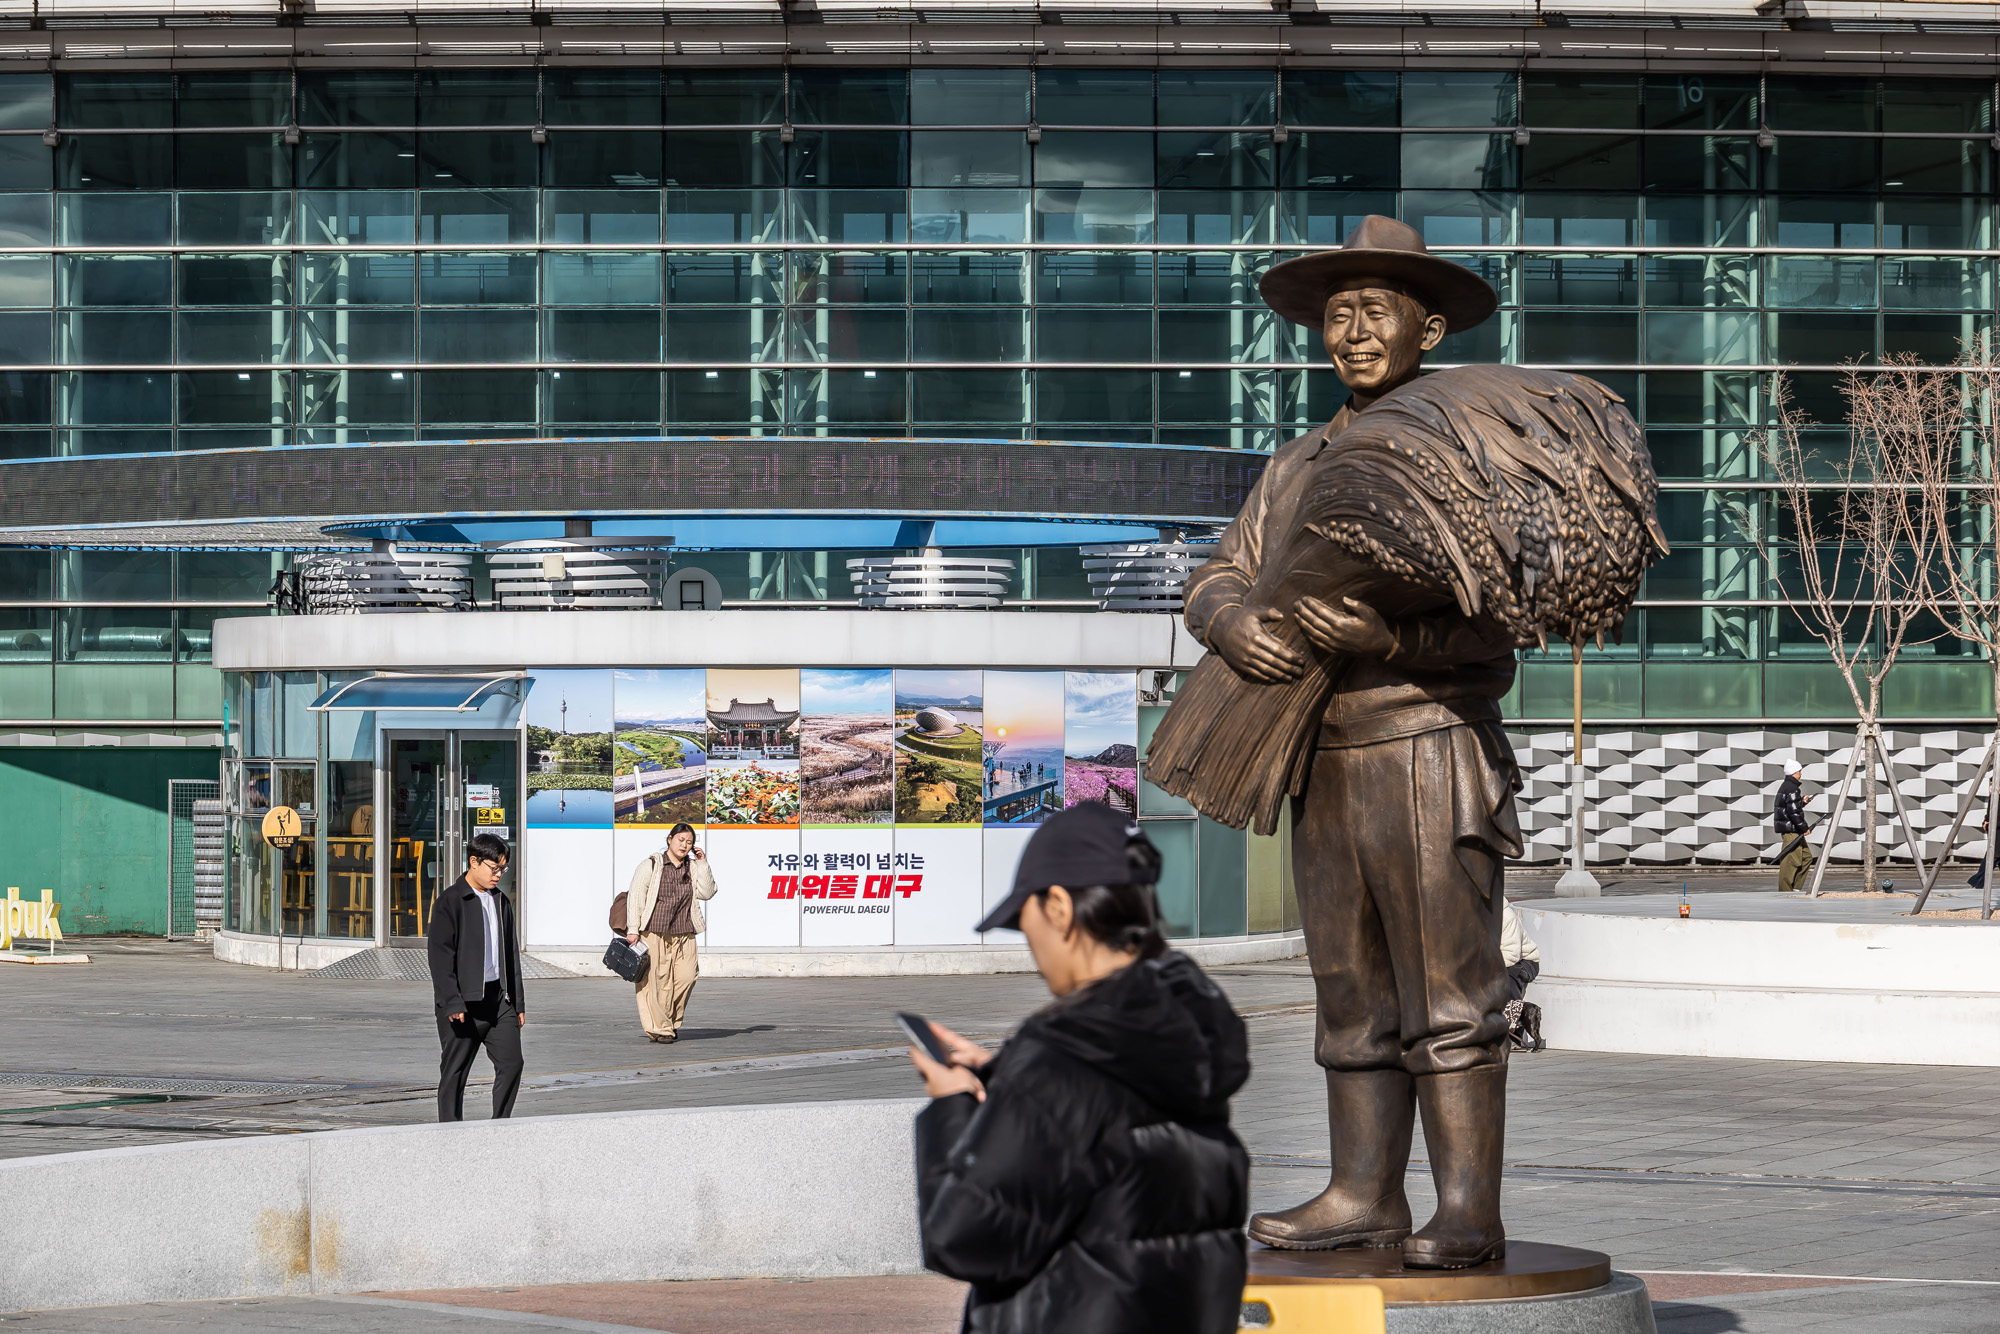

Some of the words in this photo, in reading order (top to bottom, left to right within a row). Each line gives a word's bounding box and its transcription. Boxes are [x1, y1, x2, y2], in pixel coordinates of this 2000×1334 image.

[233, 457, 414, 504] 대구경북이
[439, 454, 613, 498] 통합하면
[642, 453, 785, 495] 서울과
[810, 454, 898, 495] 함께
[768, 853, 819, 871] 자유와
[823, 853, 871, 871] 활력이
[876, 853, 925, 870] 넘치는
[767, 875, 860, 900] 파워풀
[862, 874, 924, 899] 대구
[803, 905, 856, 914] POWERFUL
[857, 905, 890, 914] DAEGU
